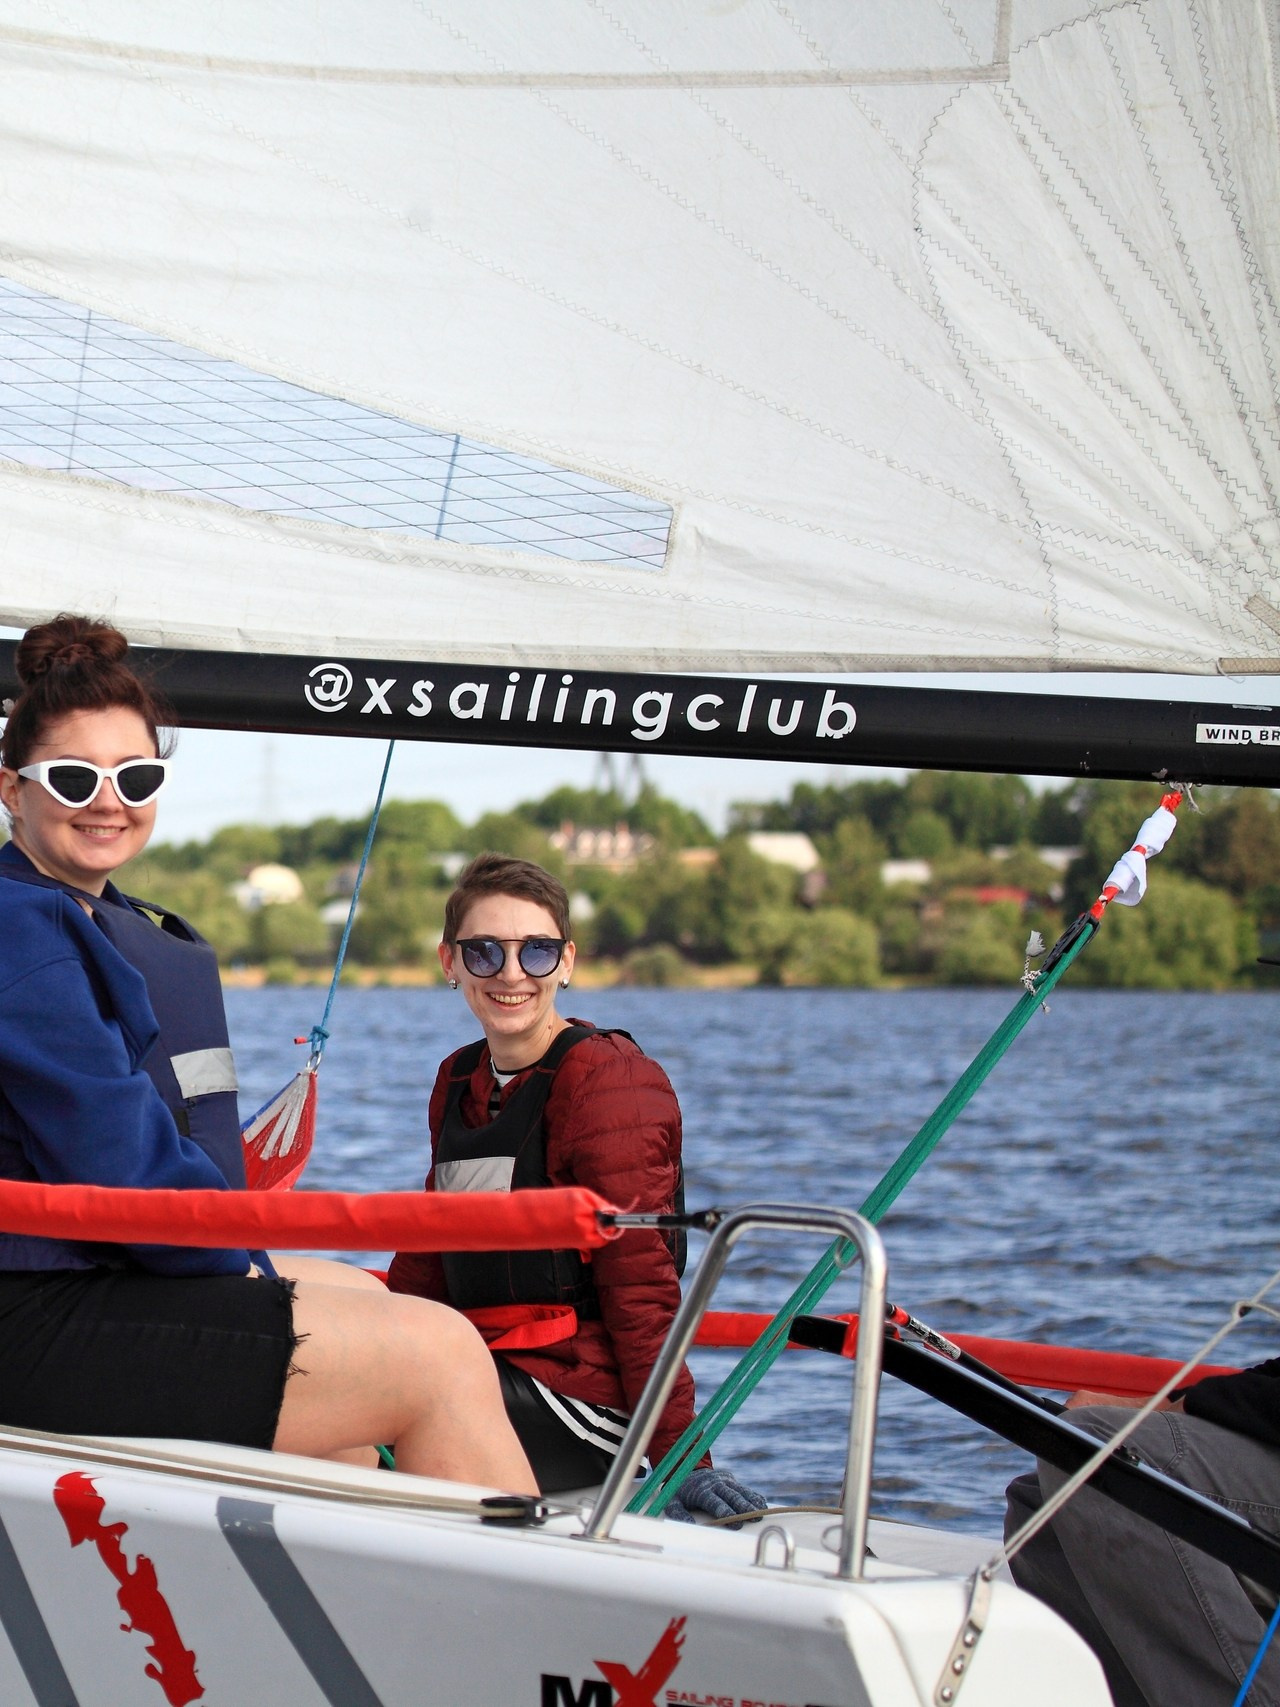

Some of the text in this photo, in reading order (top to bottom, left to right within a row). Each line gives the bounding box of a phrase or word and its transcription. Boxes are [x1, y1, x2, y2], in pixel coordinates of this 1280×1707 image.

[304, 663, 857, 741] @xsailingclub
[1206, 728, 1252, 741] WIND
[665, 1690, 734, 1707] SAILING
